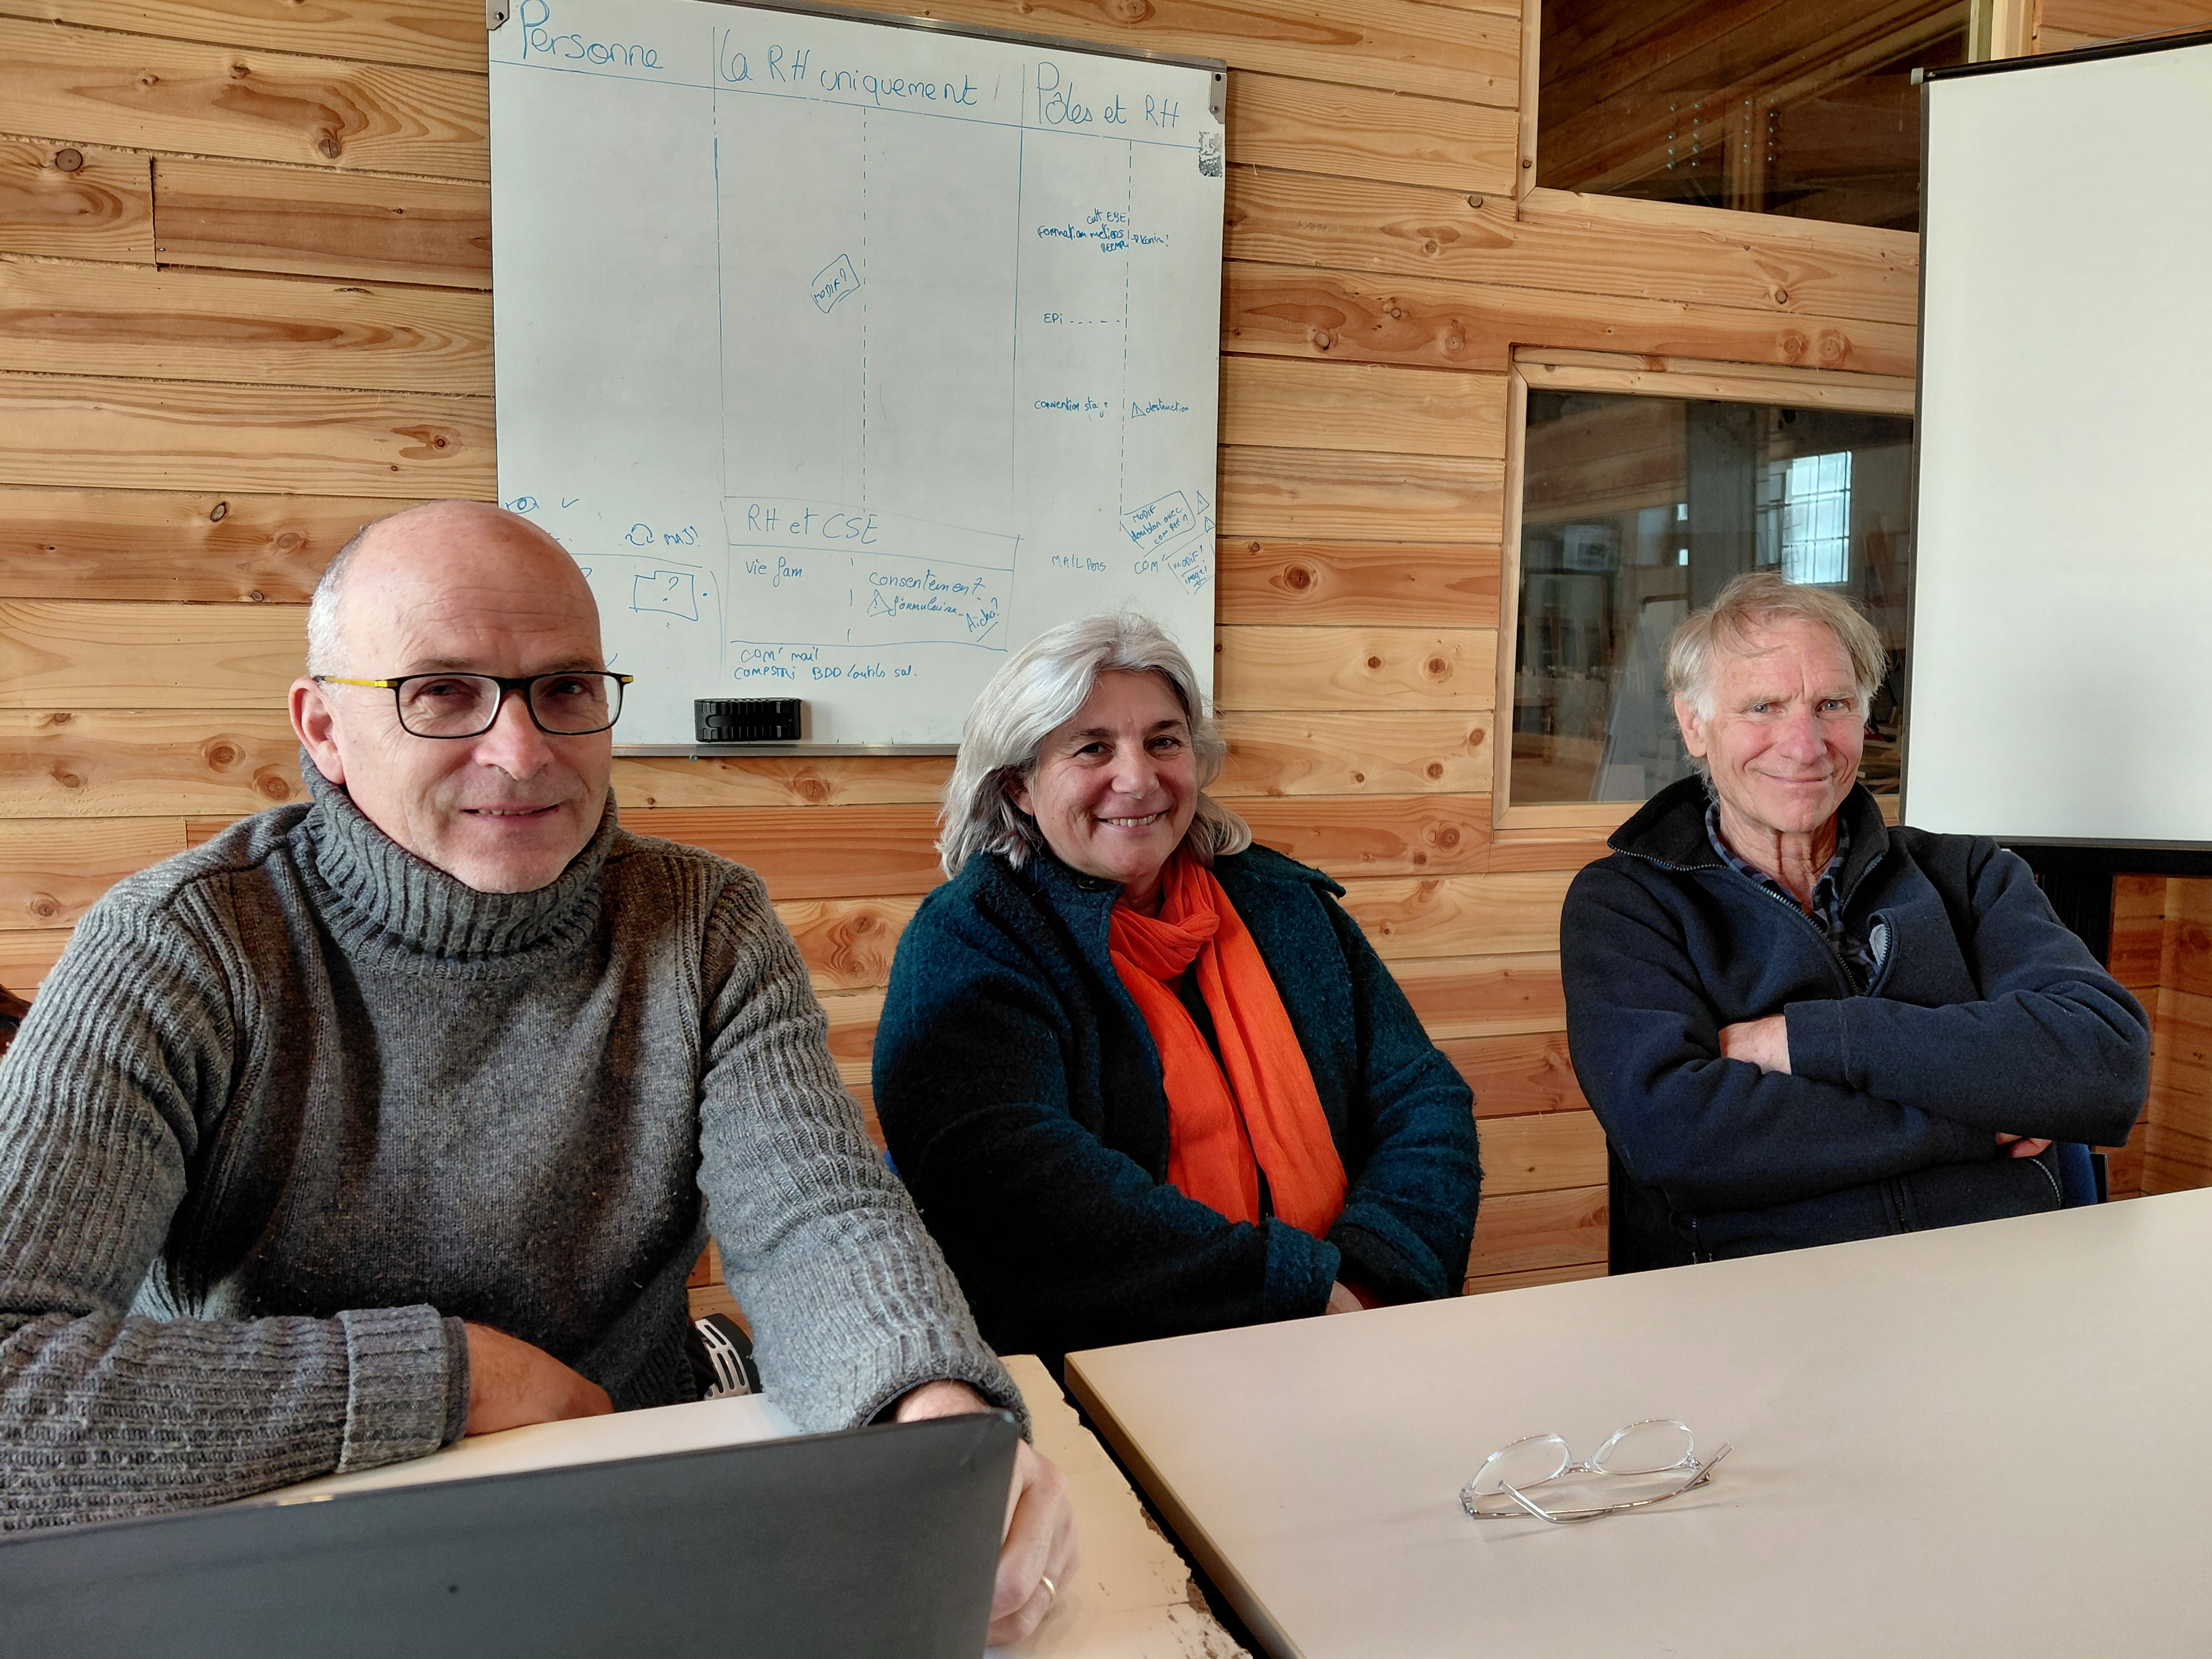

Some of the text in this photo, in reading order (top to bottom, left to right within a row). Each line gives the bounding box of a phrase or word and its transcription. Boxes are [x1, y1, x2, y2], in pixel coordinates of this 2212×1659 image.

[520, 0, 664, 69] Personne
[768, 44, 810, 82] RH
[820, 69, 978, 106] uniquement
[1036, 61, 1179, 128] Pôles et RH
[748, 503, 878, 544] RH et CSE
[1130, 520, 1162, 543] doublon
[773, 556, 803, 587] fam
[1052, 554, 1084, 569] MAIL
[791, 646, 819, 661] mail
[812, 666, 842, 680] BDD
